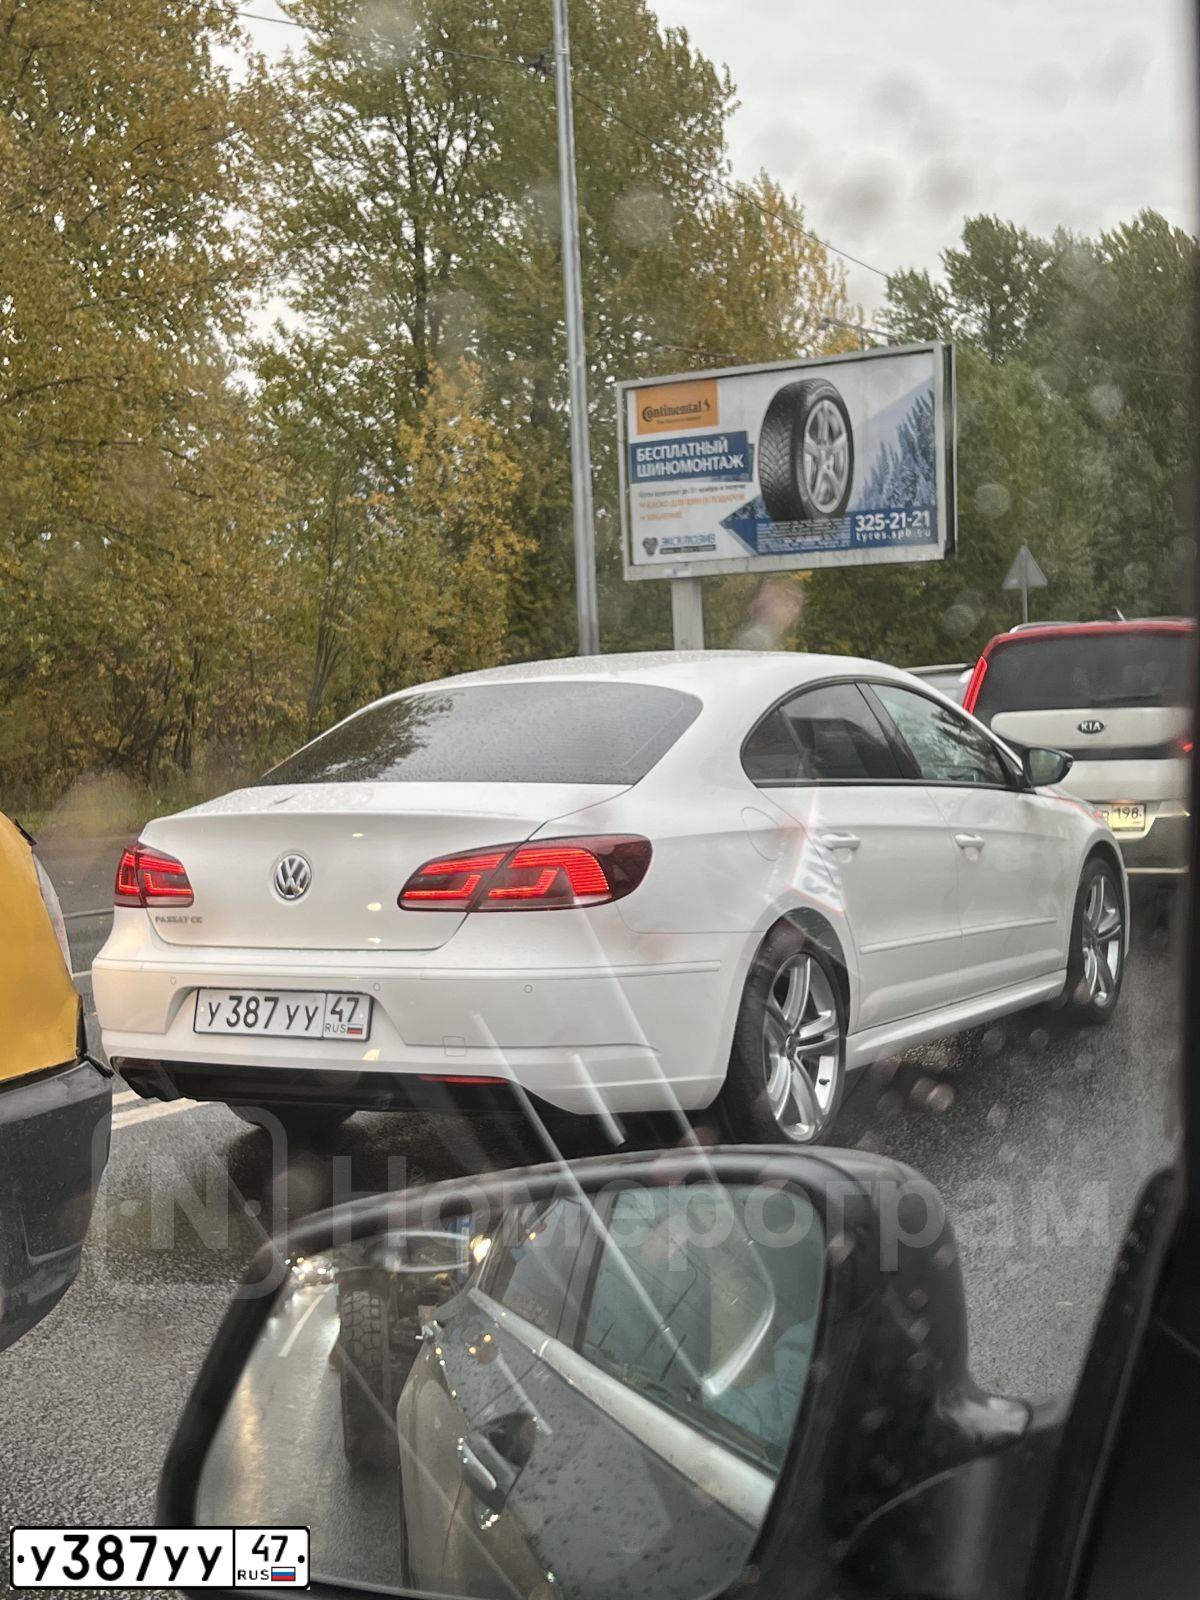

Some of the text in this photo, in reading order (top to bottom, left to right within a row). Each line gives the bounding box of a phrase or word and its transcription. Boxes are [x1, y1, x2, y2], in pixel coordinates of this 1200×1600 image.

[642, 400, 702, 422] Continental
[636, 436, 729, 462] БЕСПЛАТНЫЙ
[637, 454, 744, 478] ШИНОМОНТАЖ
[855, 510, 930, 532] 325-21-21
[1081, 721, 1101, 731] KIA
[1113, 806, 1139, 819] 198
[330, 996, 360, 1023] 47
[325, 1023, 346, 1034] RUS
